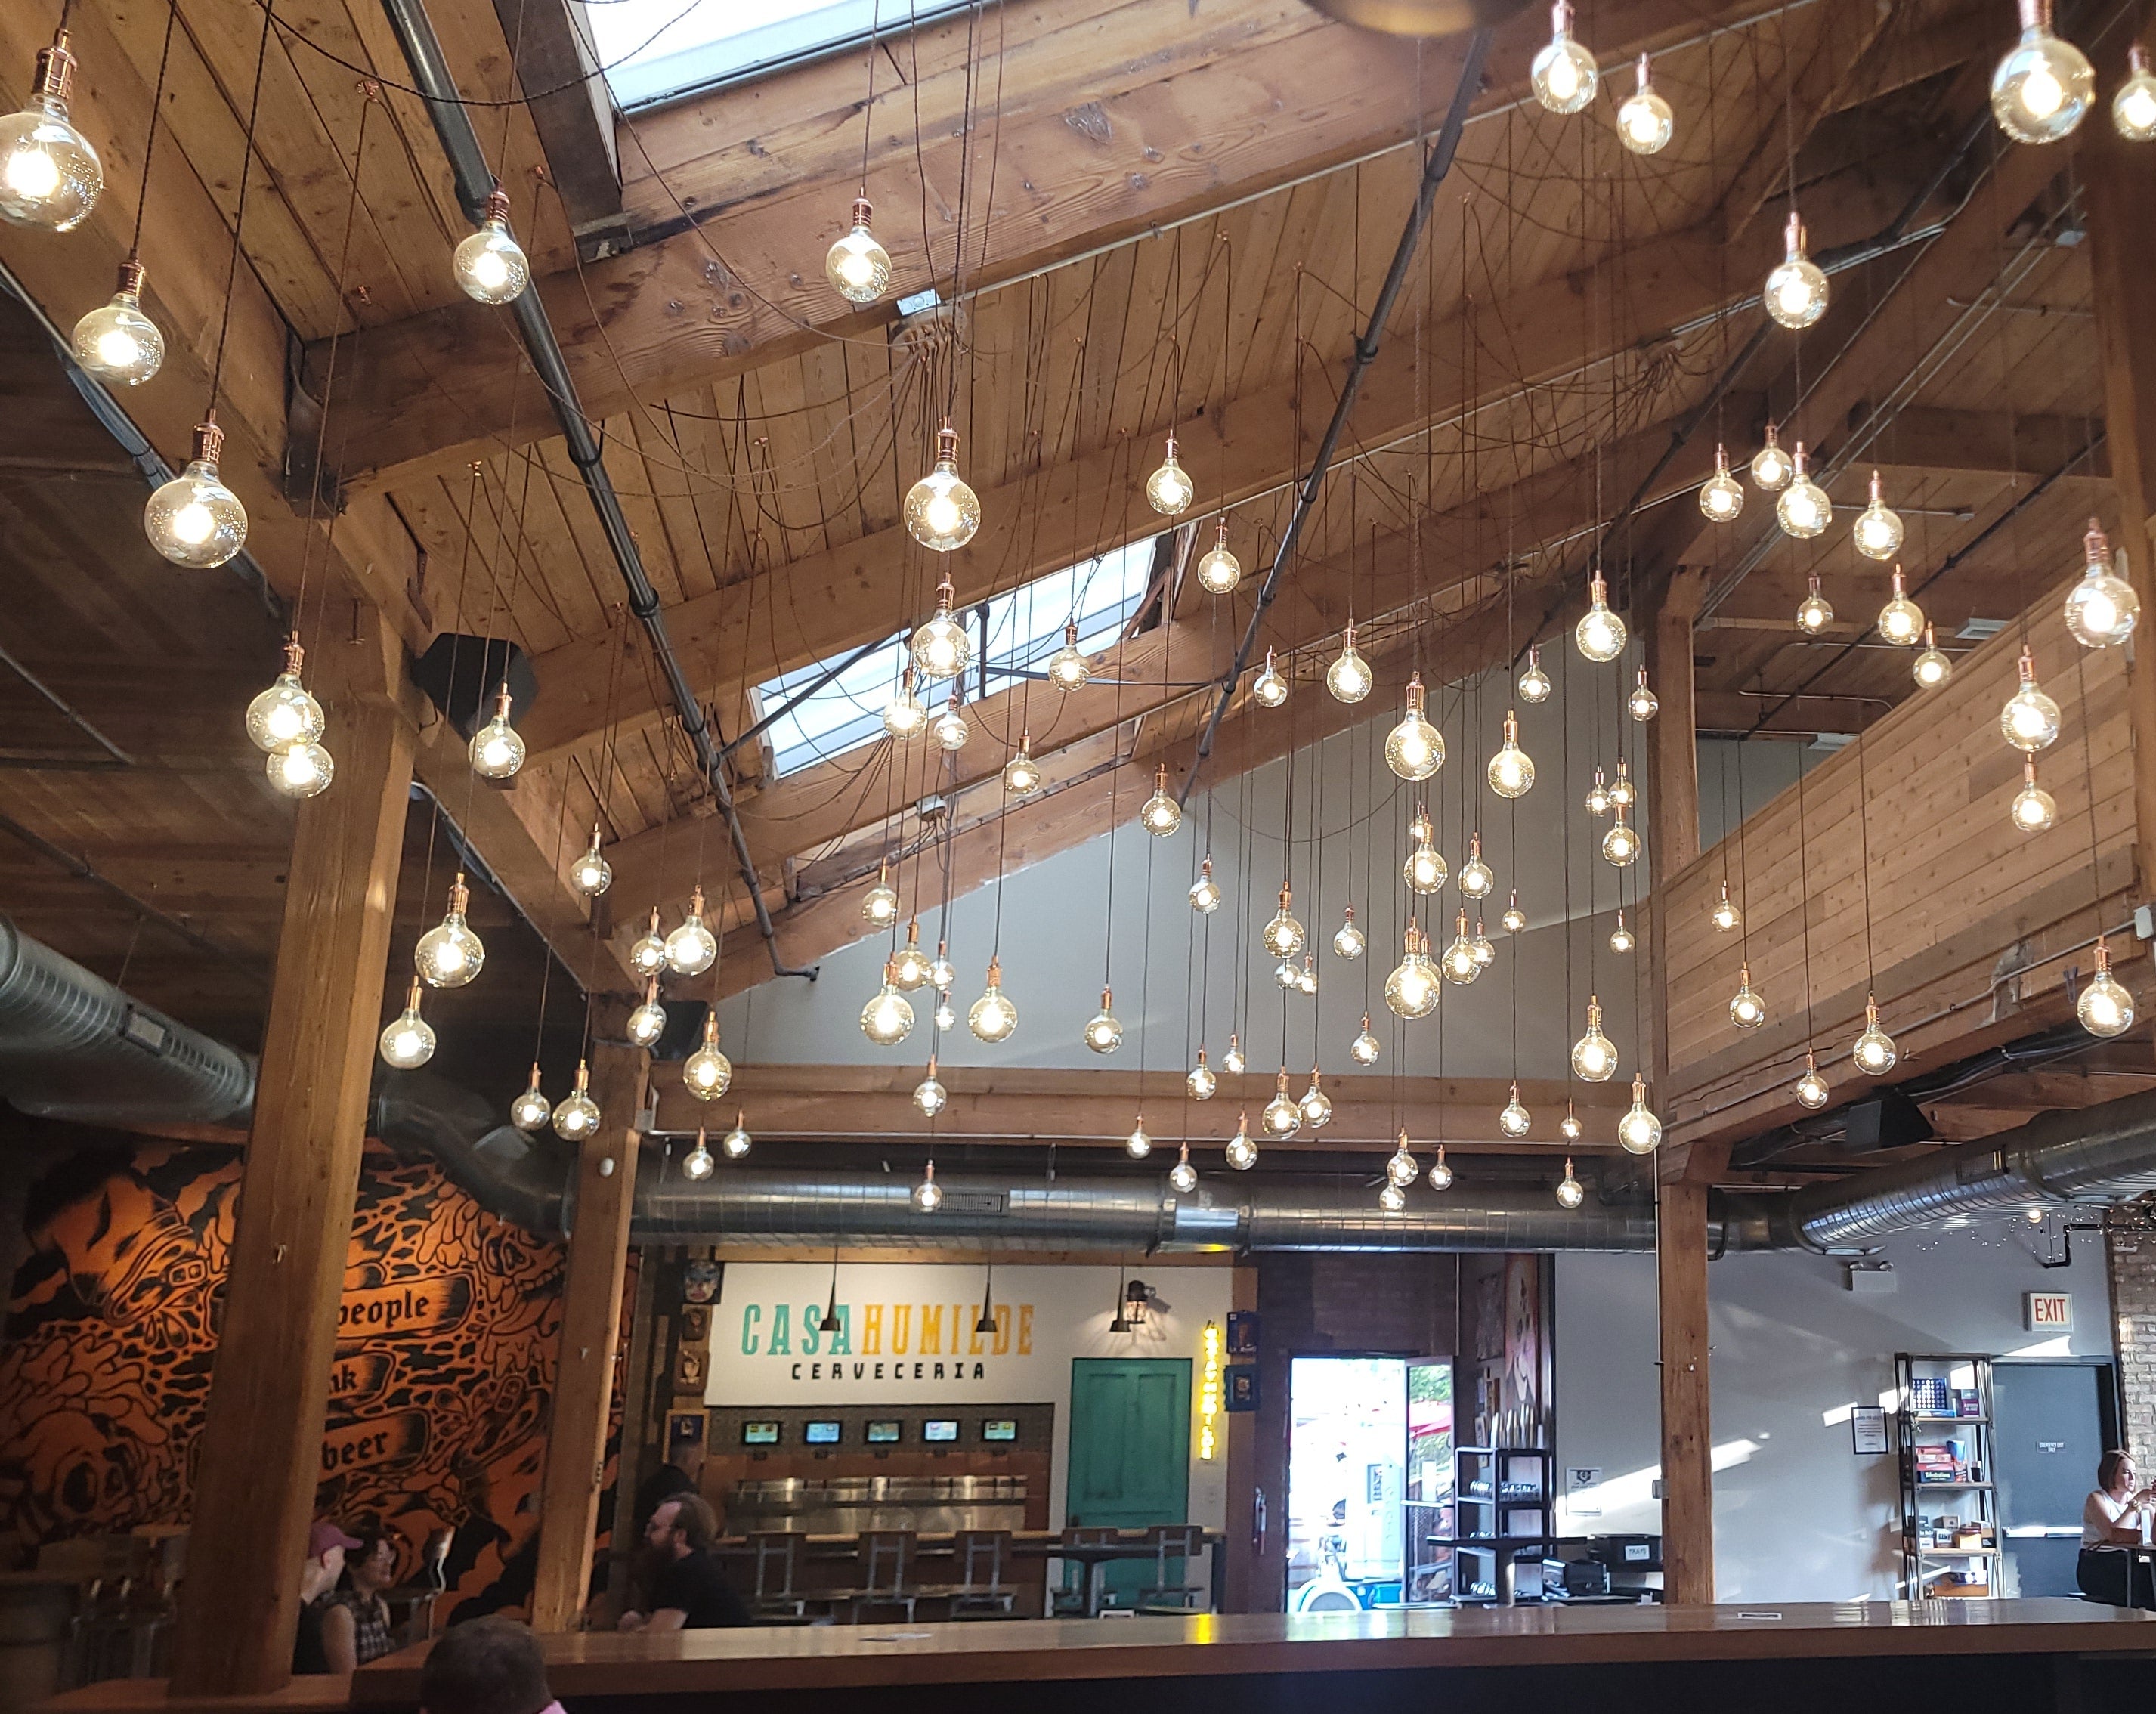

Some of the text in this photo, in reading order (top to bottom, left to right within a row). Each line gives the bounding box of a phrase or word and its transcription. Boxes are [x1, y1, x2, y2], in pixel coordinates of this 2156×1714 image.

[2034, 1298, 2065, 1322] EXIT
[791, 1363, 985, 1381] CERVECERIA
[321, 1431, 388, 1471] beer
